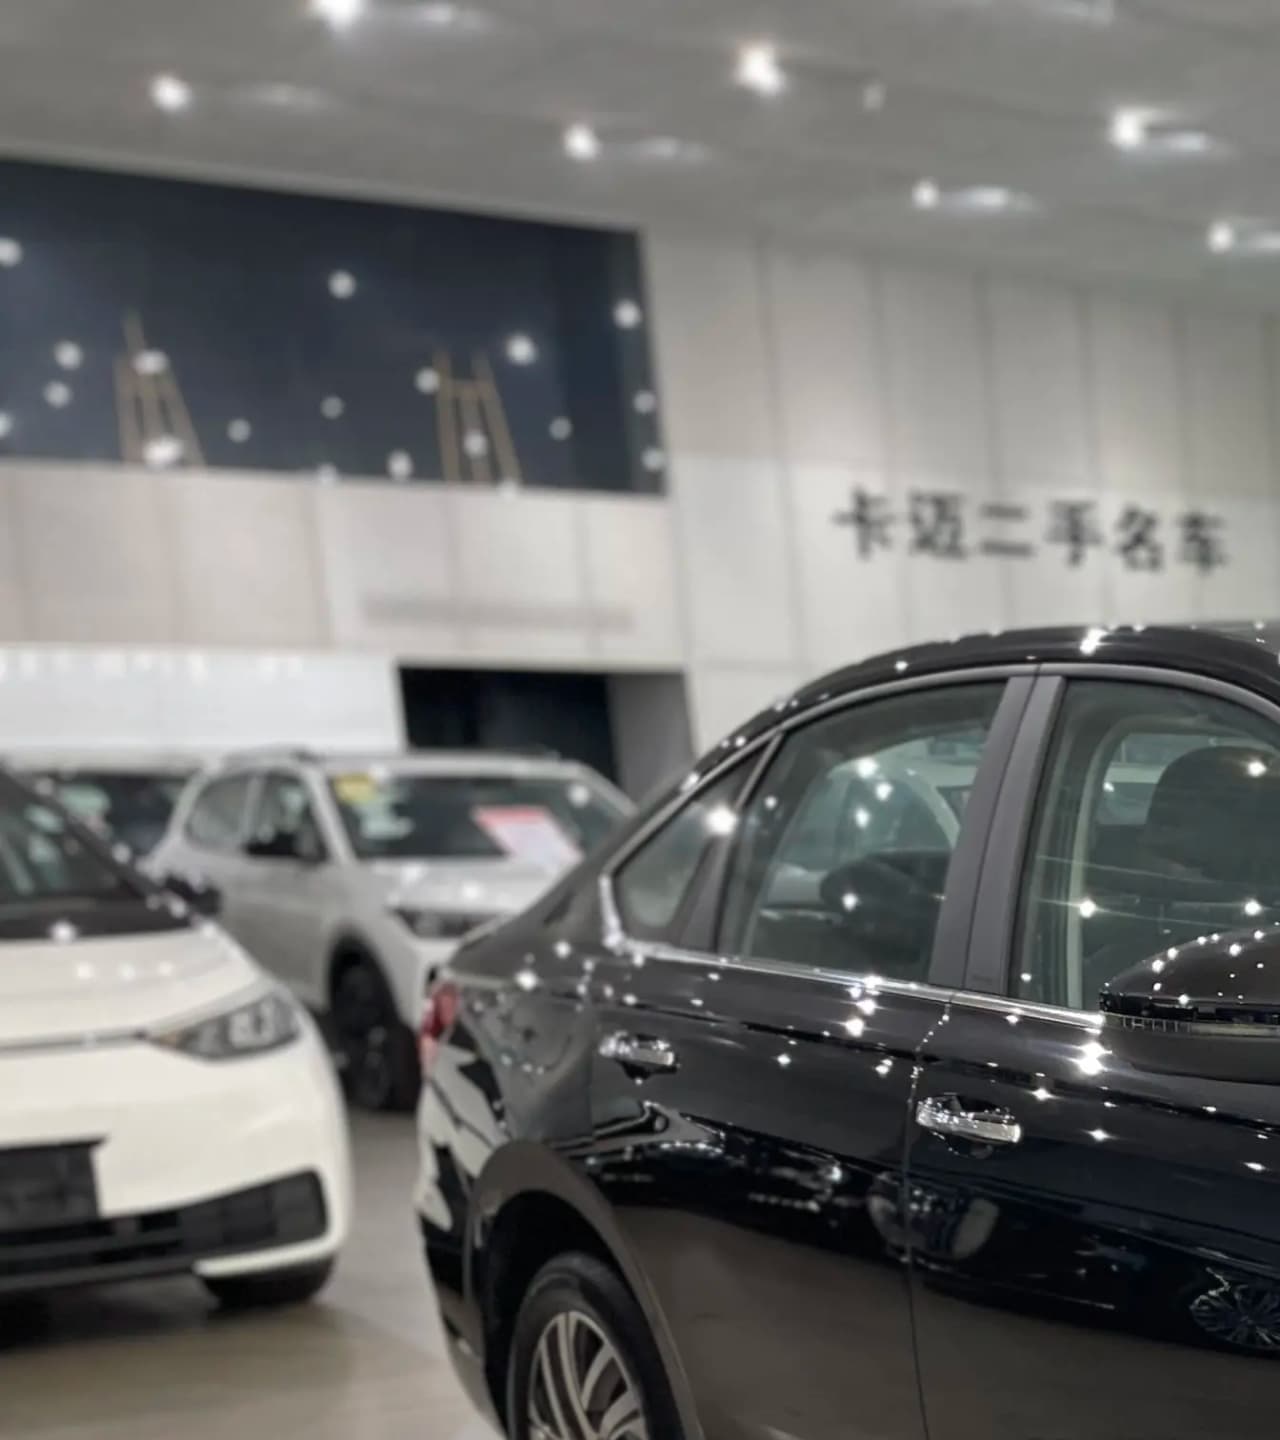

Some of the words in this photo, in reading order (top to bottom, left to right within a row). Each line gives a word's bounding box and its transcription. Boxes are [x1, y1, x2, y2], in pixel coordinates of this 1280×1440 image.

[832, 485, 1229, 574] 卡迈二手名车
